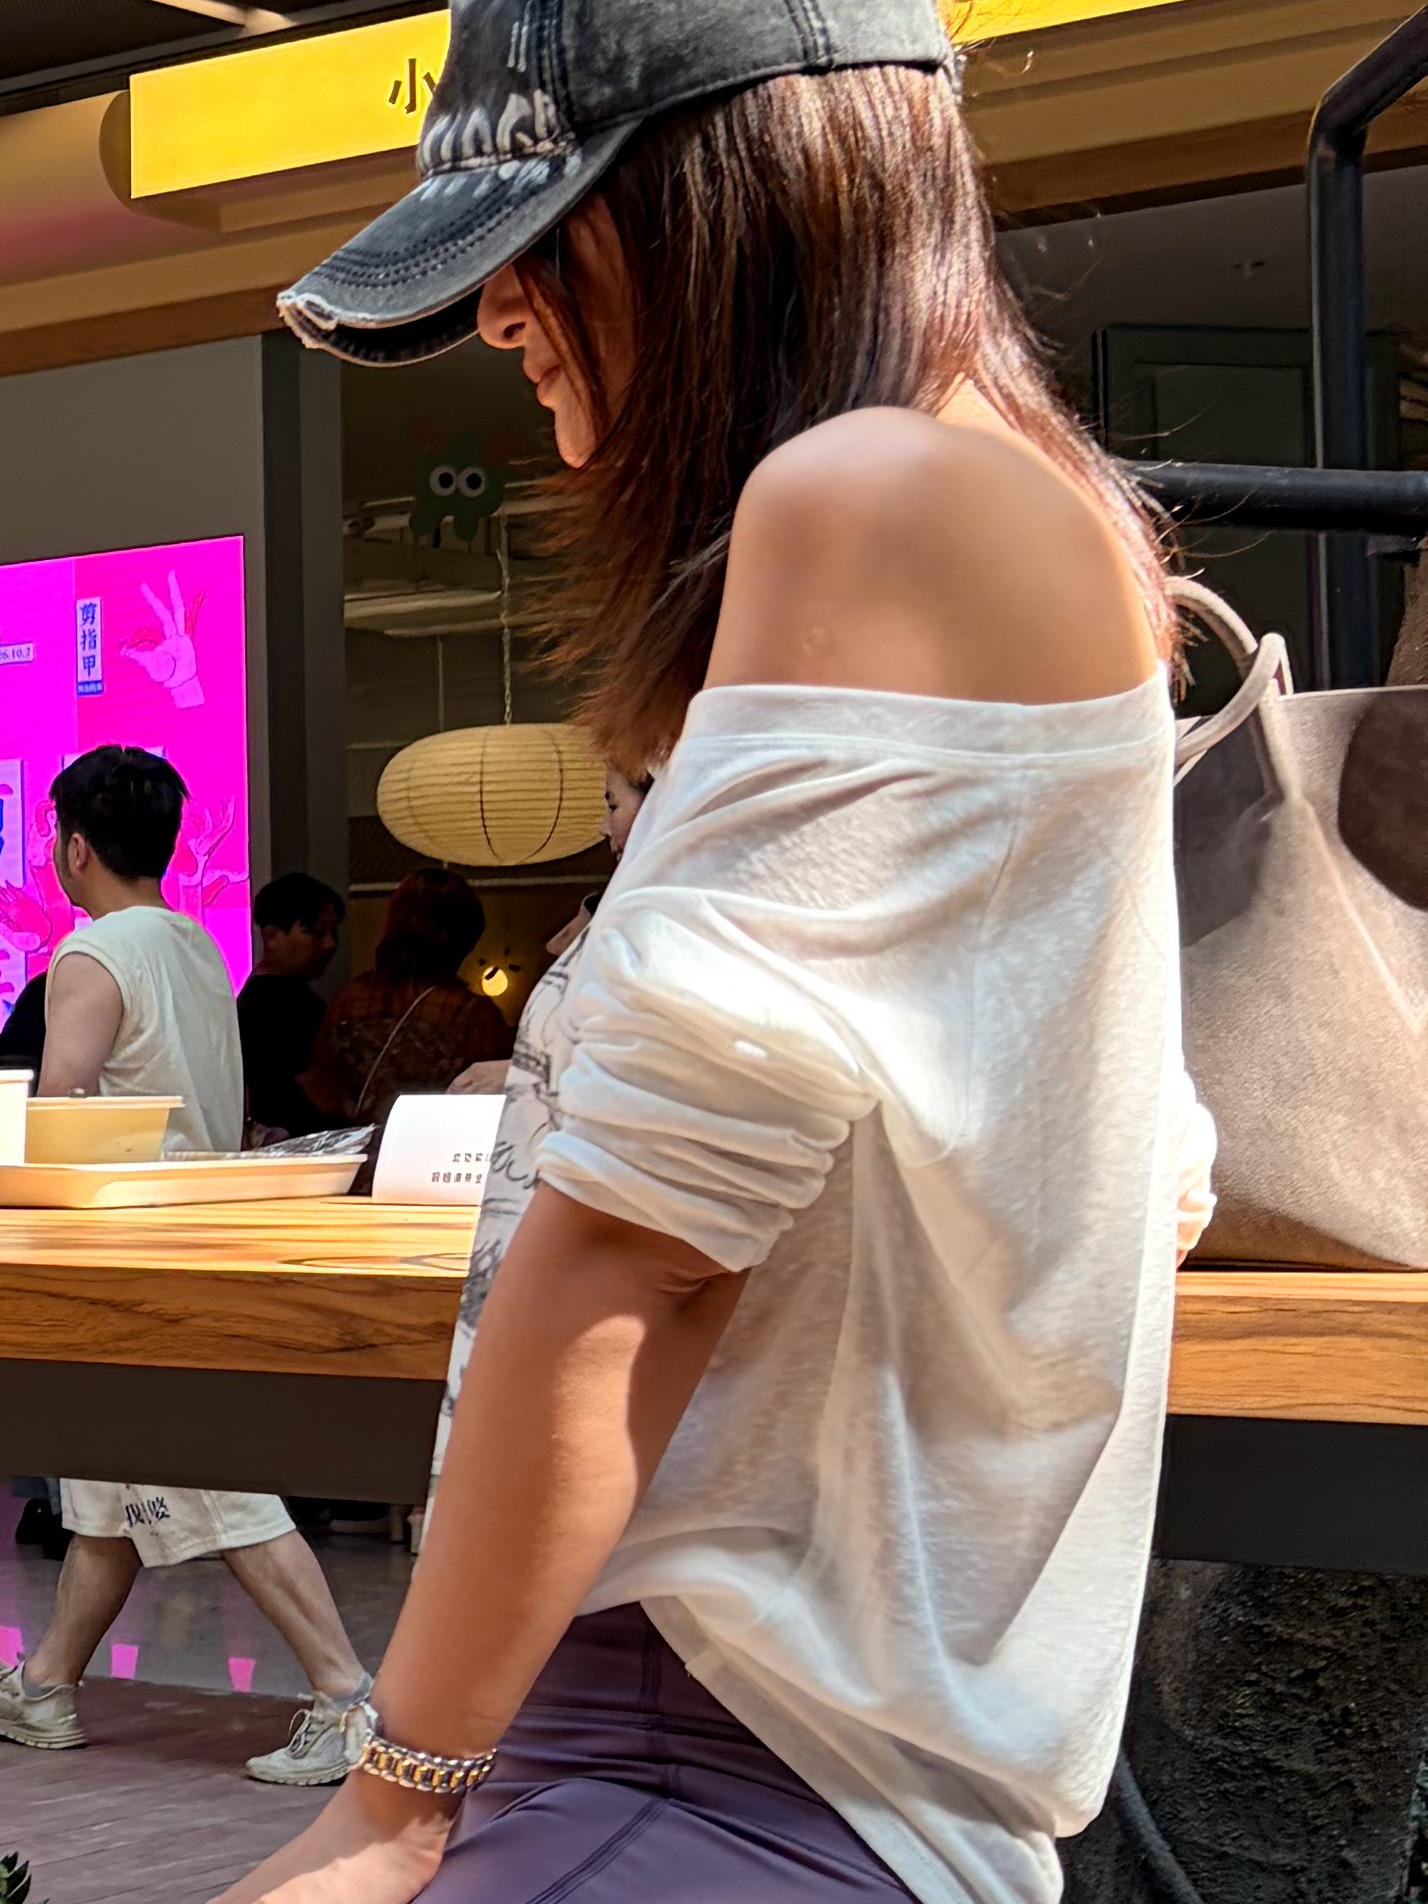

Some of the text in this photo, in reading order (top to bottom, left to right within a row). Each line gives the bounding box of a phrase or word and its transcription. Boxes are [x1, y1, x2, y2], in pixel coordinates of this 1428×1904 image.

[388, 58, 438, 114] 小
[80, 602, 98, 678] 剪指甲
